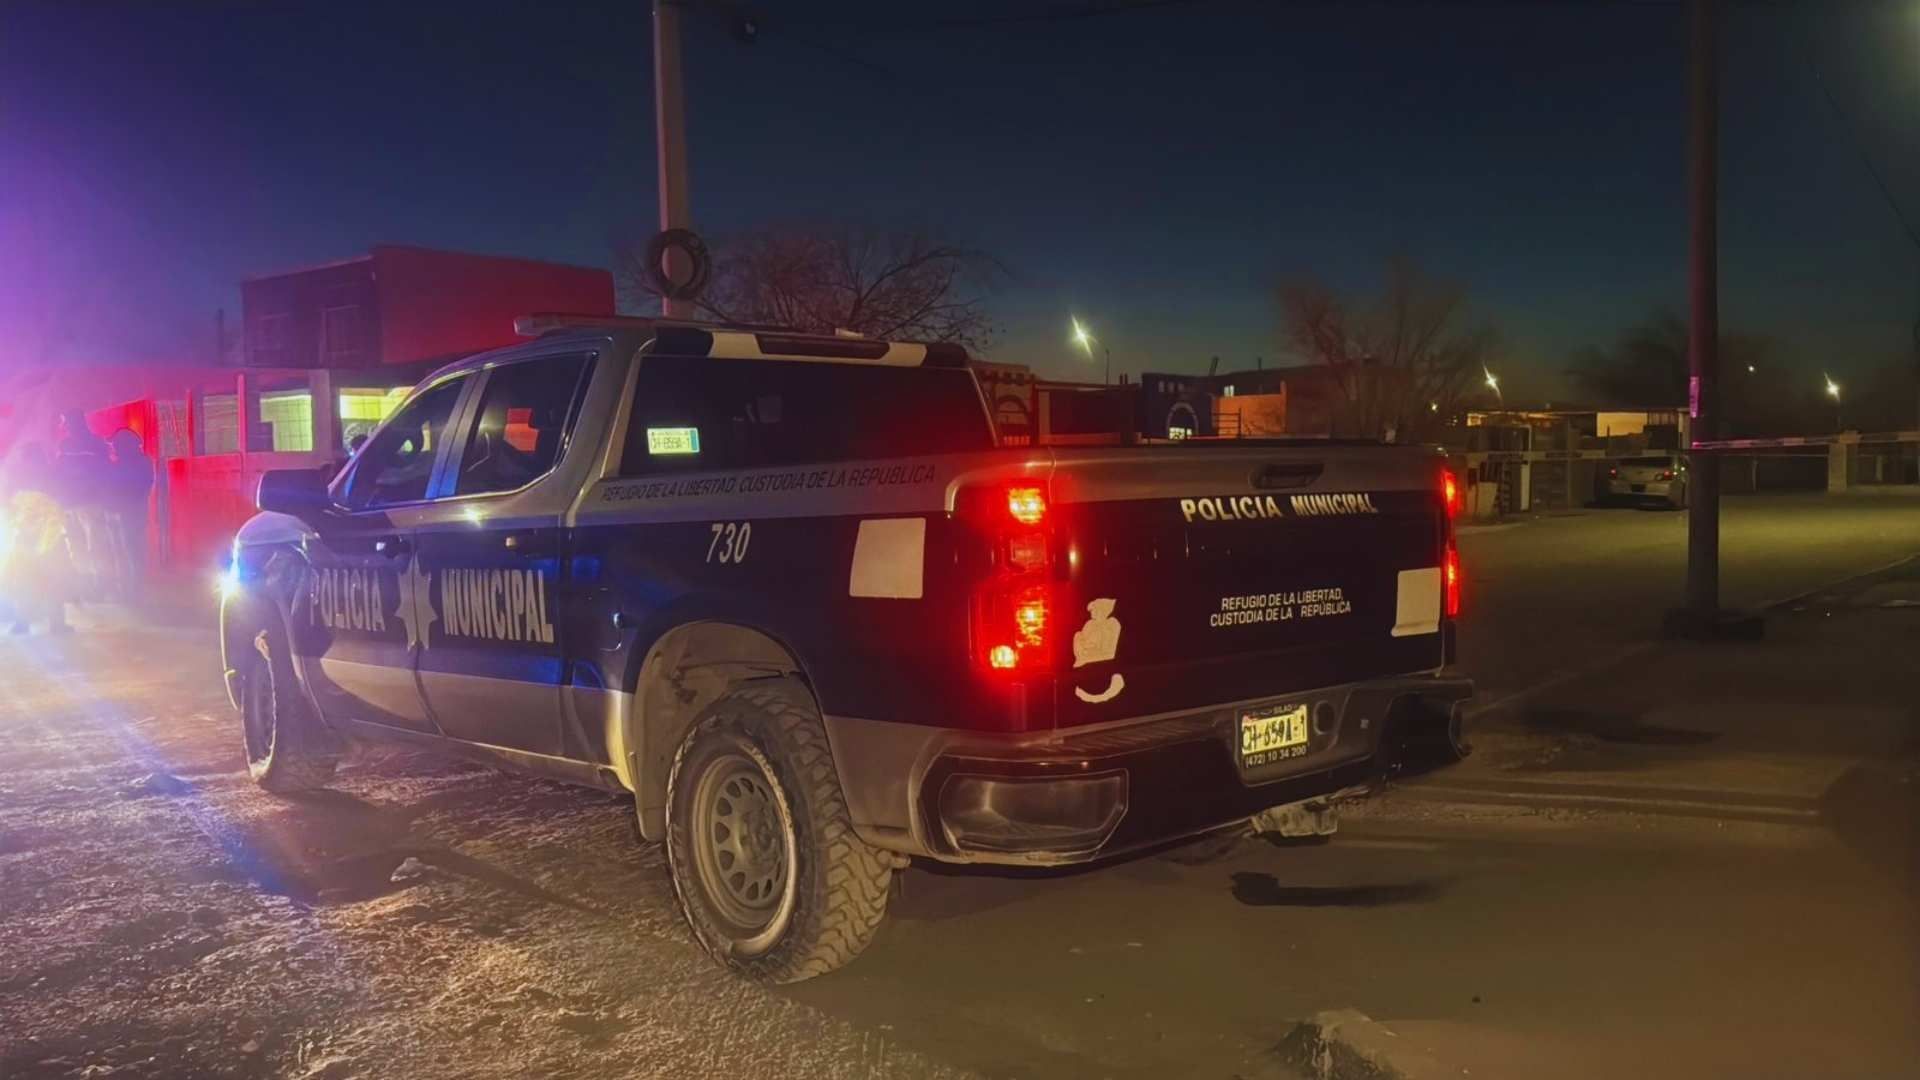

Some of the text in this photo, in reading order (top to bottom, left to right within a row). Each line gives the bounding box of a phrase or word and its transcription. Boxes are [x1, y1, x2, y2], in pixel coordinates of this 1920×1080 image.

[646, 483, 664, 499] DE
[664, 481, 678, 497] LA
[738, 472, 804, 493] CUSTODIA
[807, 471, 827, 489] DE
[827, 469, 847, 487] LA
[1180, 493, 1378, 522] POLICIA MUNICIPAL
[706, 522, 751, 564] 730
[310, 568, 554, 643] POLICIA MUNICIPAL
[1221, 594, 1267, 611] REFUGIO
[1268, 593, 1281, 606] DE
[1283, 592, 1295, 605] LA
[1210, 610, 1264, 627] CUSTODIA
[1265, 608, 1279, 621] DE
[1280, 607, 1293, 619] LA
